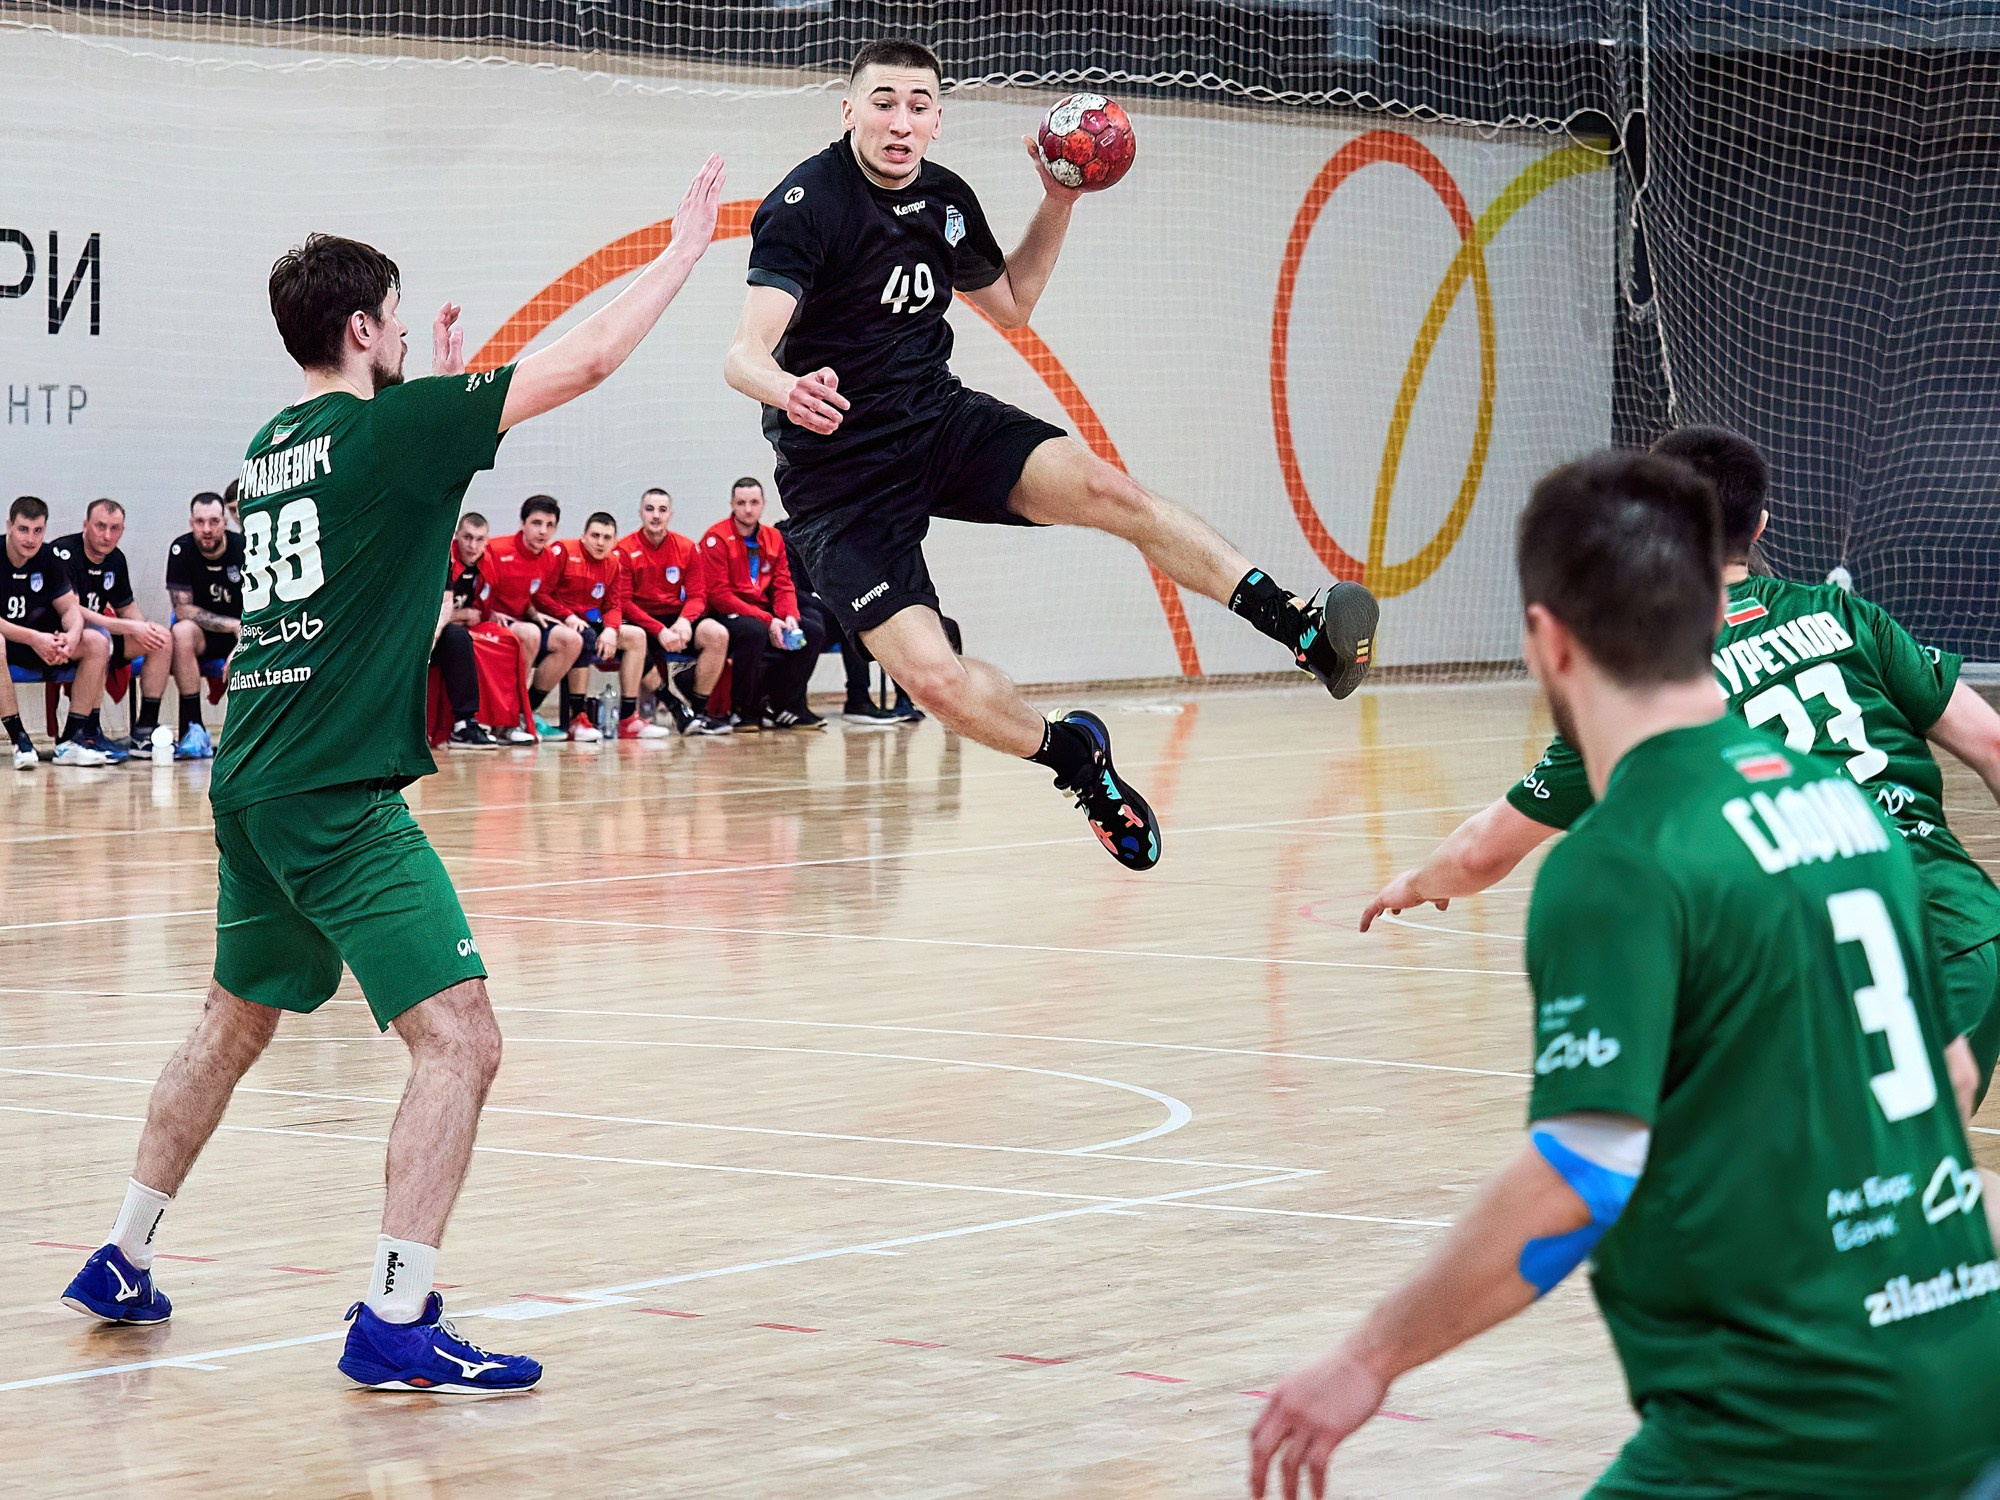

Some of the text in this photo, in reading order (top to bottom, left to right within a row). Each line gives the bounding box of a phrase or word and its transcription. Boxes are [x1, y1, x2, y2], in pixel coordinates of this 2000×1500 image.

[893, 200, 926, 217] Kempa
[880, 262, 935, 314] 49
[240, 497, 325, 613] 88
[7, 595, 26, 619] 93
[851, 581, 890, 612] Kempa
[229, 666, 312, 692] zilant.team
[1711, 611, 1854, 701] УРЕТКОВ
[1825, 886, 1938, 1123] 3
[383, 1250, 400, 1296] MIKASA
